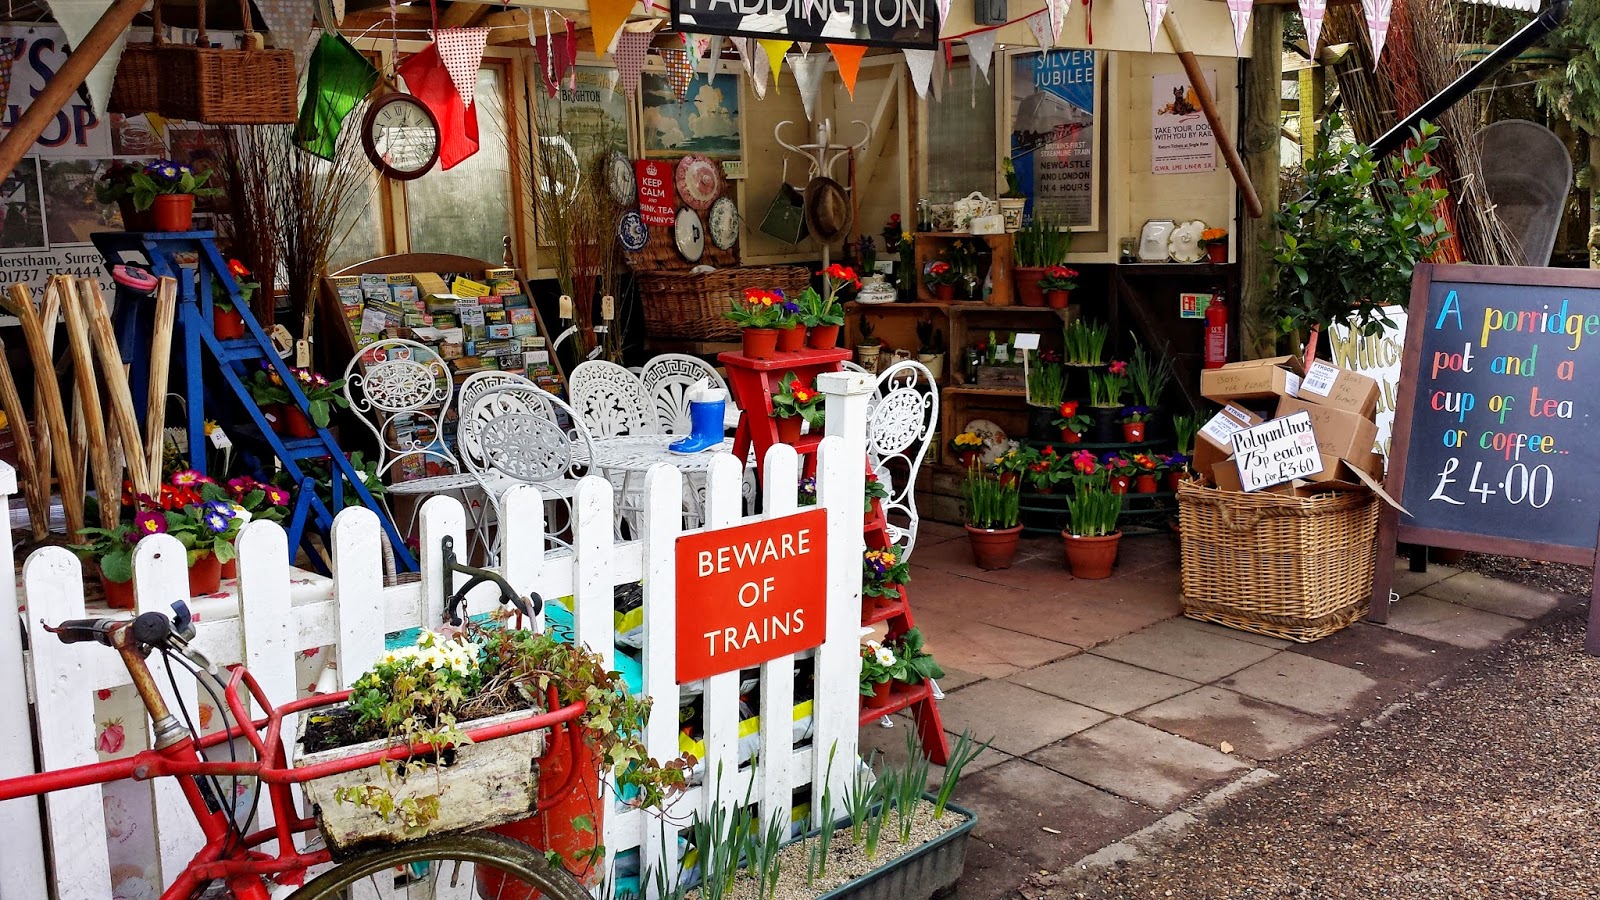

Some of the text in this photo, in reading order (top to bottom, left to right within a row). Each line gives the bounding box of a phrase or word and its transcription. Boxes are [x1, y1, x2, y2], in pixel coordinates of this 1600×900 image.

[689, 0, 926, 29] DDINGTON
[1036, 50, 1093, 70] SILVER
[1035, 69, 1093, 88] JUBILEE
[1154, 126, 1171, 134] TAKE
[1173, 125, 1192, 133] YOUR
[1198, 130, 1213, 138] RAIL
[1074, 148, 1091, 156] TRAIN
[1040, 160, 1090, 170] NEWCASTLE
[642, 177, 662, 187] KEEP
[1040, 171, 1090, 181] AND LONDON
[640, 187, 665, 198] CALM
[1040, 183, 1090, 192] IN 4 HOURS
[646, 214, 675, 224] FANNY'S
[657, 206, 675, 215] TEA
[0, 252, 105, 267] erstham, Surrey
[0, 269, 39, 283] 01737
[1435, 290, 1600, 351] A porridge
[1329, 316, 1403, 372] Willo
[1431, 342, 1575, 381] pot and a
[1431, 386, 1574, 424] cup of tea
[1233, 418, 1312, 453] Polyanthus
[1443, 429, 1467, 448] or
[1240, 441, 1315, 470] 75p each or
[1251, 469, 1261, 486] 6
[1264, 472, 1278, 485] for
[698, 529, 810, 577] BEWARE
[738, 577, 775, 608] OF
[703, 608, 804, 656] TRAINS
